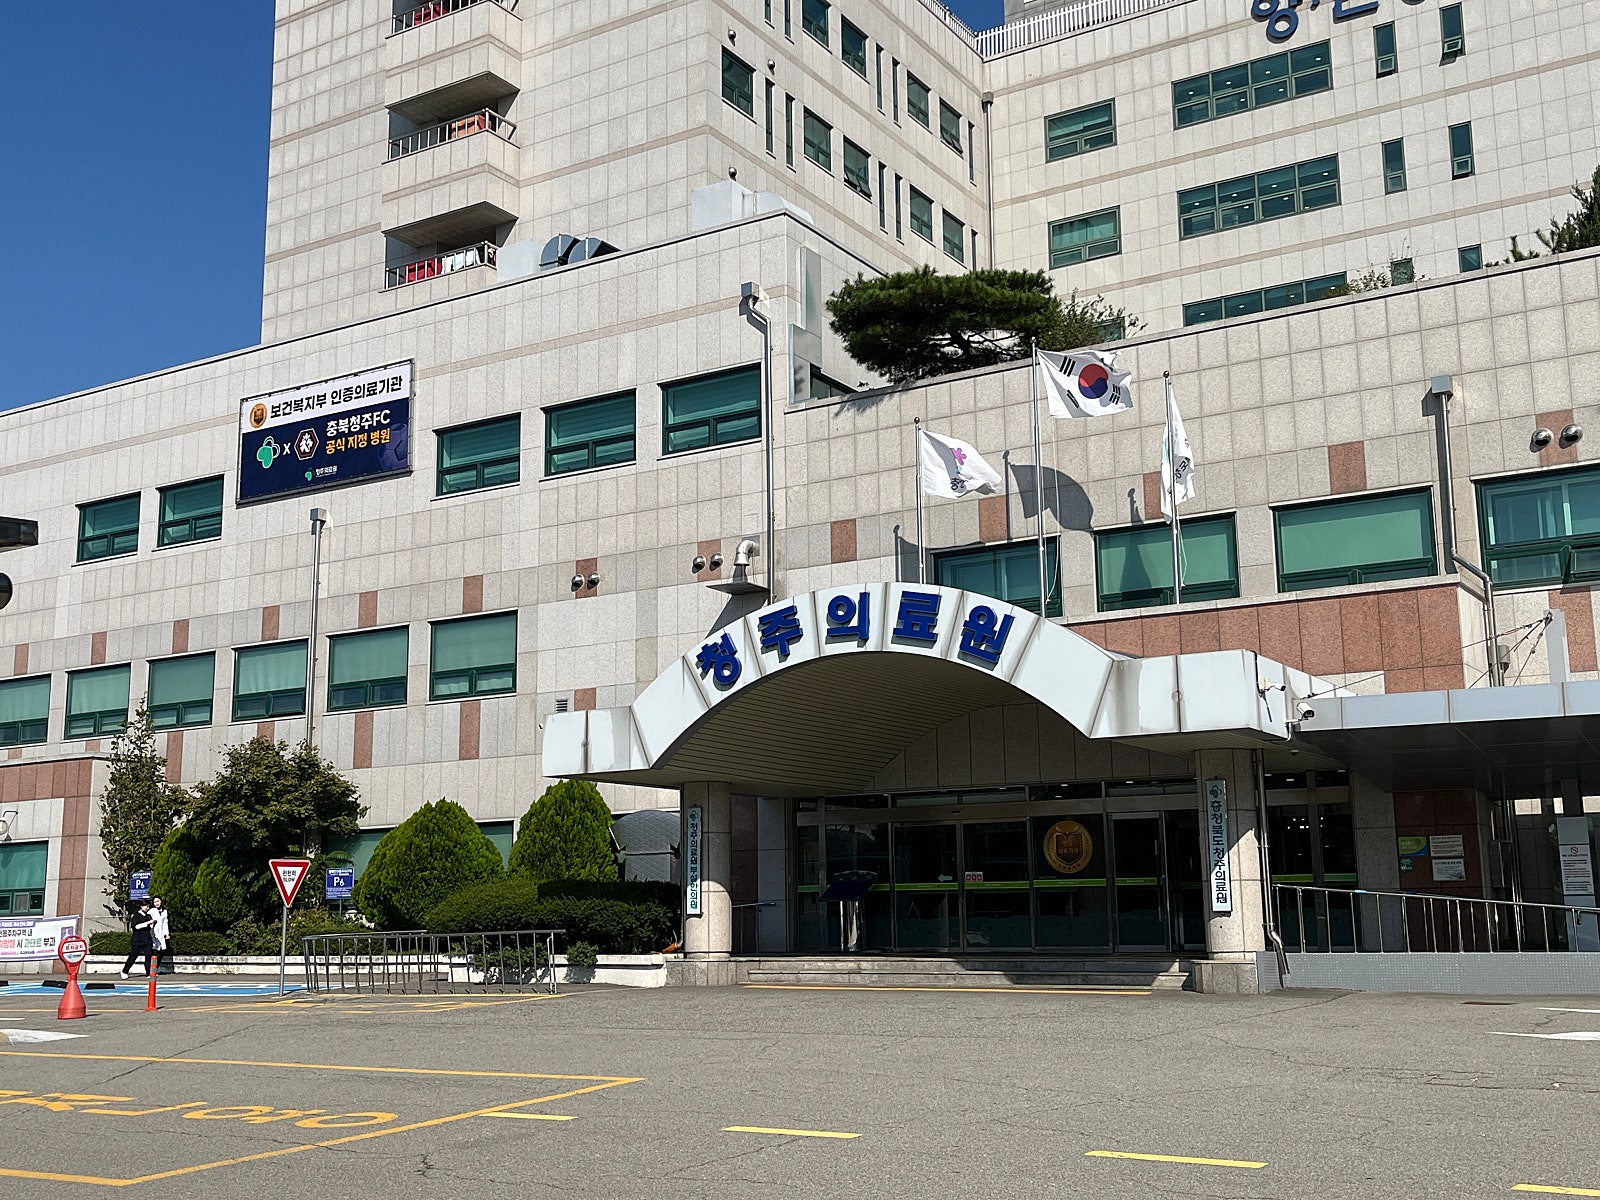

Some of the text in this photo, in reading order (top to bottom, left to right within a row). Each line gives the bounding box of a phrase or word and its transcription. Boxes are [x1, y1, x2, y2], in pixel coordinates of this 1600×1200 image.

[270, 375, 403, 419] 보건복지부 인증의료기관
[326, 409, 391, 437] 충북청주FC
[325, 428, 391, 455] 공식 지정 병원
[697, 591, 1015, 685] 청주의료원
[690, 822, 698, 865] 청주의료원
[1211, 800, 1227, 904] 충청북도 청주의료원
[135, 879, 145, 889] P6
[282, 869, 297, 877] 천천히
[333, 876, 345, 887] P6
